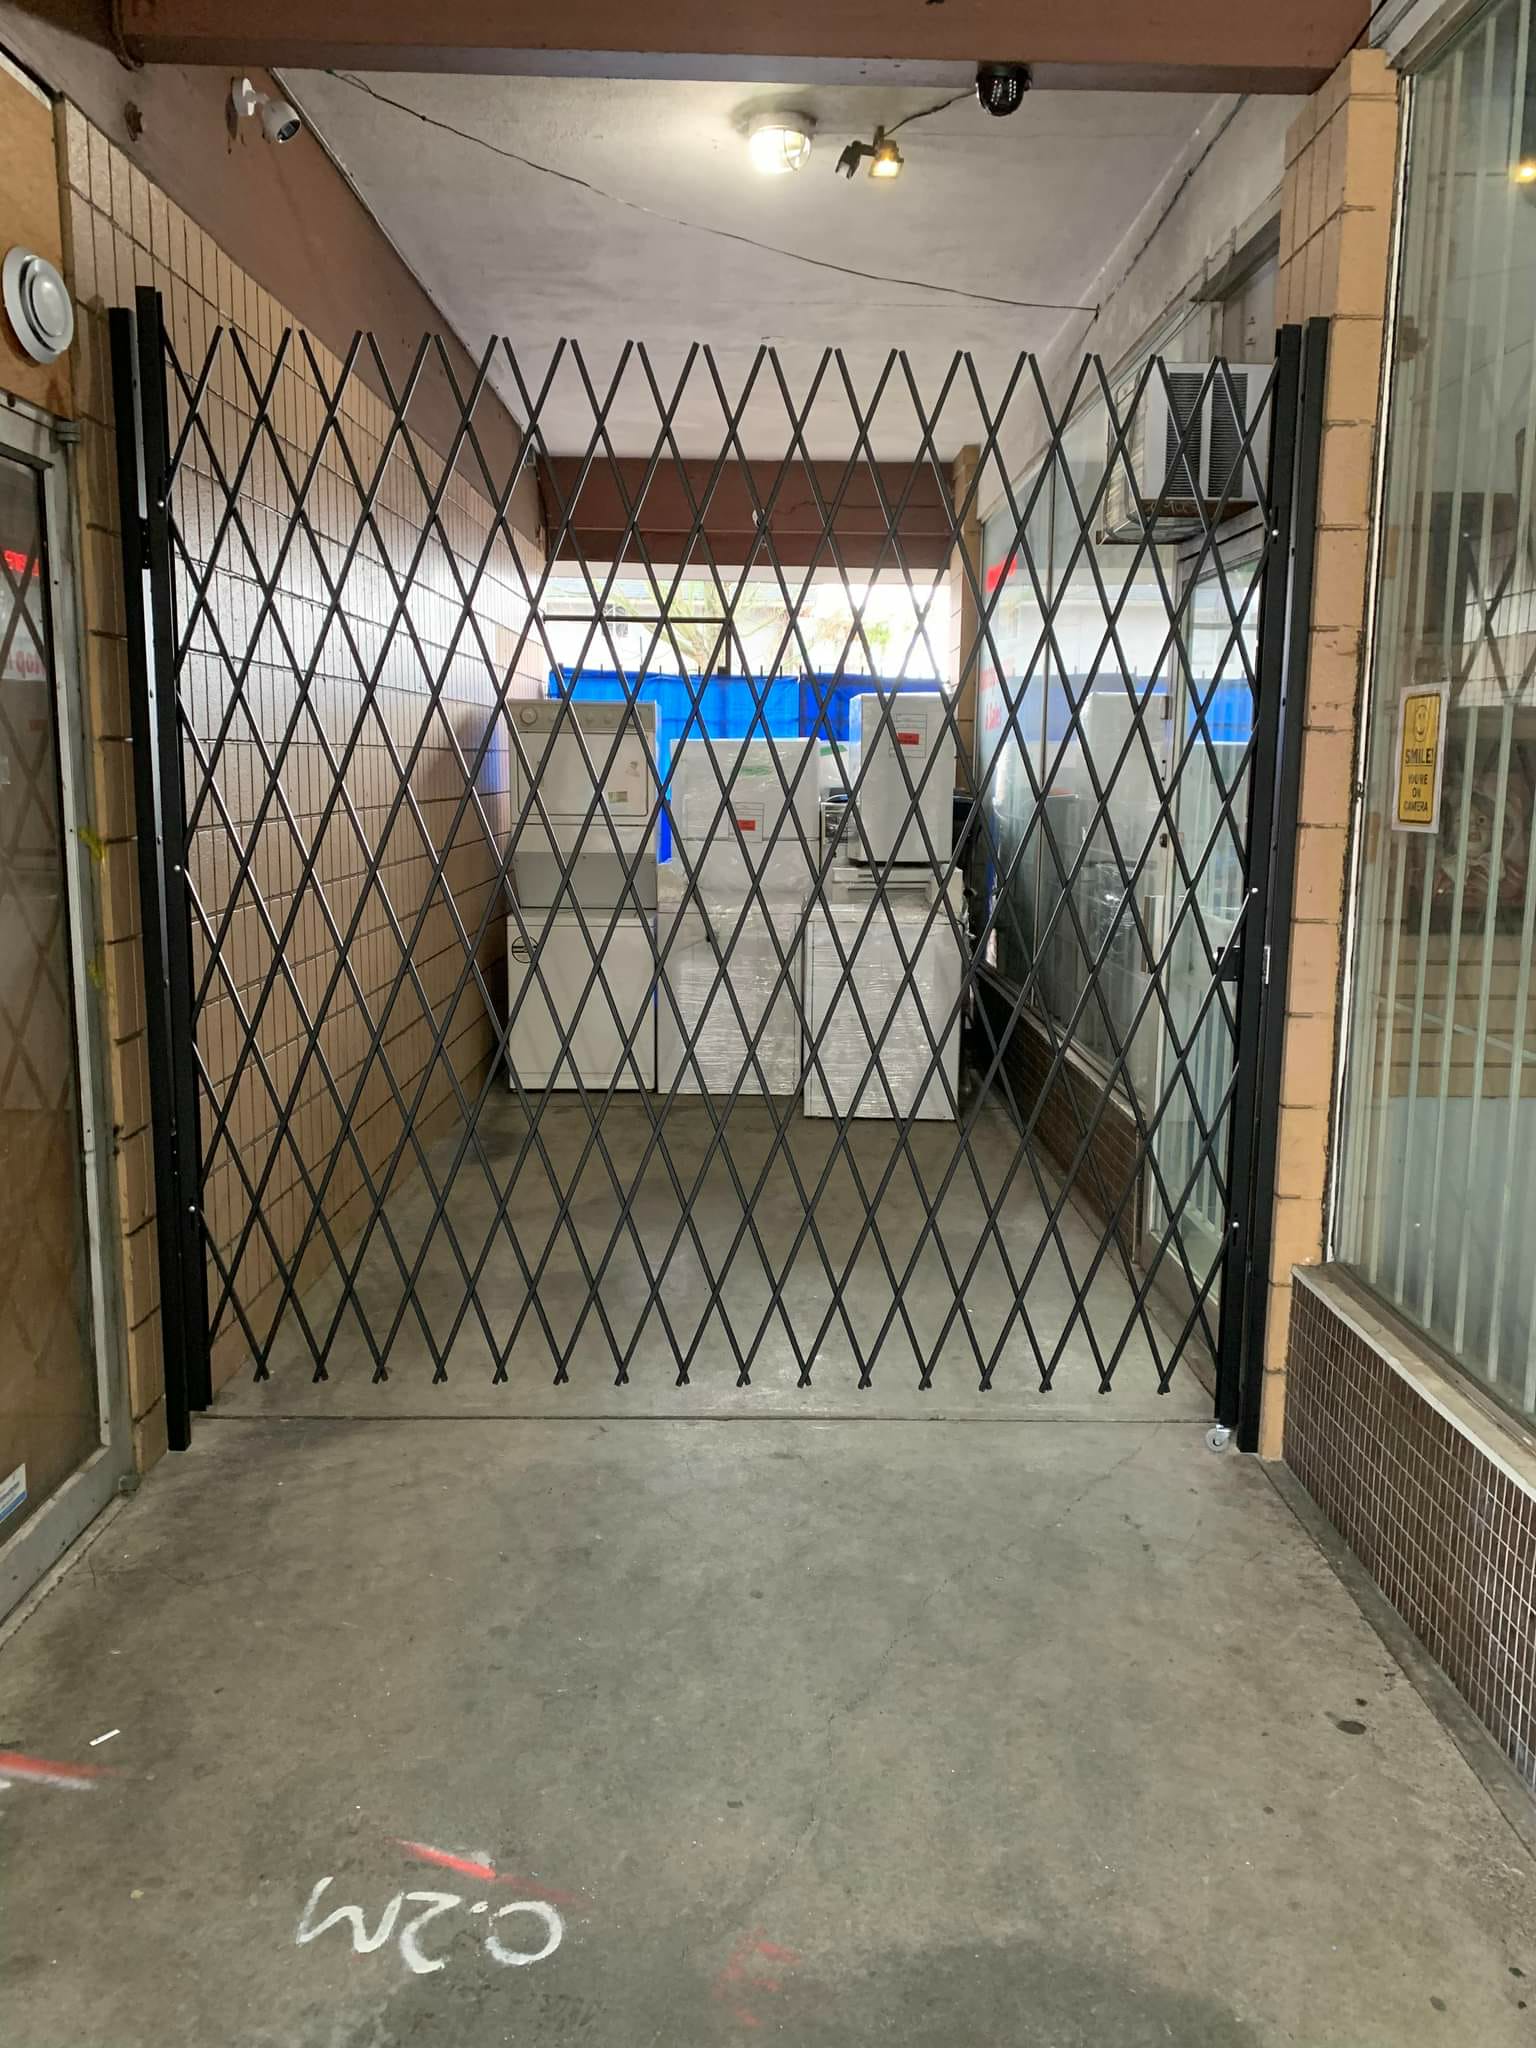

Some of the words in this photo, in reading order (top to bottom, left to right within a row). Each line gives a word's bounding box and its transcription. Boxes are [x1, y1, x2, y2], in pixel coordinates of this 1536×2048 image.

[1405, 748, 1433, 764] SMILE!
[1408, 774, 1428, 784] YOU'RE
[1412, 787, 1421, 798] ON
[1403, 800, 1428, 811] CAMERA
